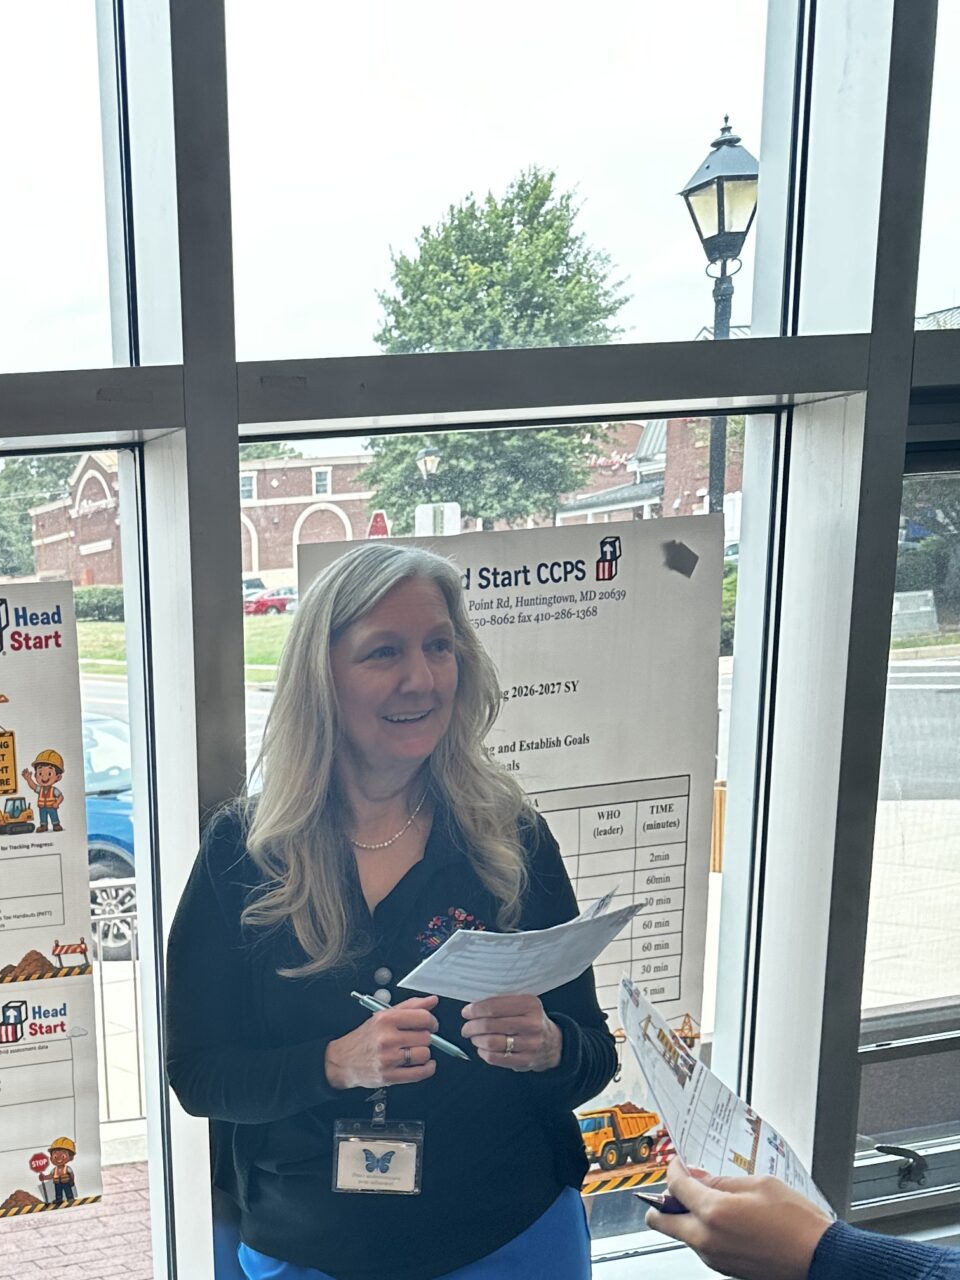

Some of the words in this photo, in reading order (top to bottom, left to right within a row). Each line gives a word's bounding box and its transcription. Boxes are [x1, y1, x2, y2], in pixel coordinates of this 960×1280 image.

[478, 565, 531, 590] Start
[536, 559, 586, 584] CCPS
[468, 599, 494, 611] Point
[496, 597, 513, 609] Rd,
[515, 593, 578, 608] Huntingtown,
[580, 590, 597, 601] MD
[598, 588, 627, 600] 20639
[14, 605, 62, 627] Head
[517, 611, 532, 624] fax
[533, 605, 598, 623] 410-286-1368
[10, 630, 62, 651] Start
[511, 682, 562, 699] 2026-2027
[563, 680, 580, 694] SY
[498, 741, 516, 754] and
[519, 736, 562, 752] Establish
[564, 733, 590, 747] Goals
[597, 809, 621, 821] WHO
[649, 803, 675, 815] TIME
[593, 825, 624, 839] (leader)
[642, 818, 680, 833] (minutes)
[9, 843, 30, 851] Tracking
[649, 852, 670, 863] 2min
[646, 873, 671, 885] 60min
[655, 896, 671, 906] min
[642, 920, 652, 930] 60
[654, 919, 670, 928] min
[641, 942, 652, 952] 60
[653, 941, 669, 951] min
[641, 965, 651, 975] 30
[653, 963, 668, 973] min
[649, 986, 665, 995] min
[32, 1003, 67, 1020] Head
[28, 1021, 66, 1037] Start
[32, 1158, 48, 1168] STOP
